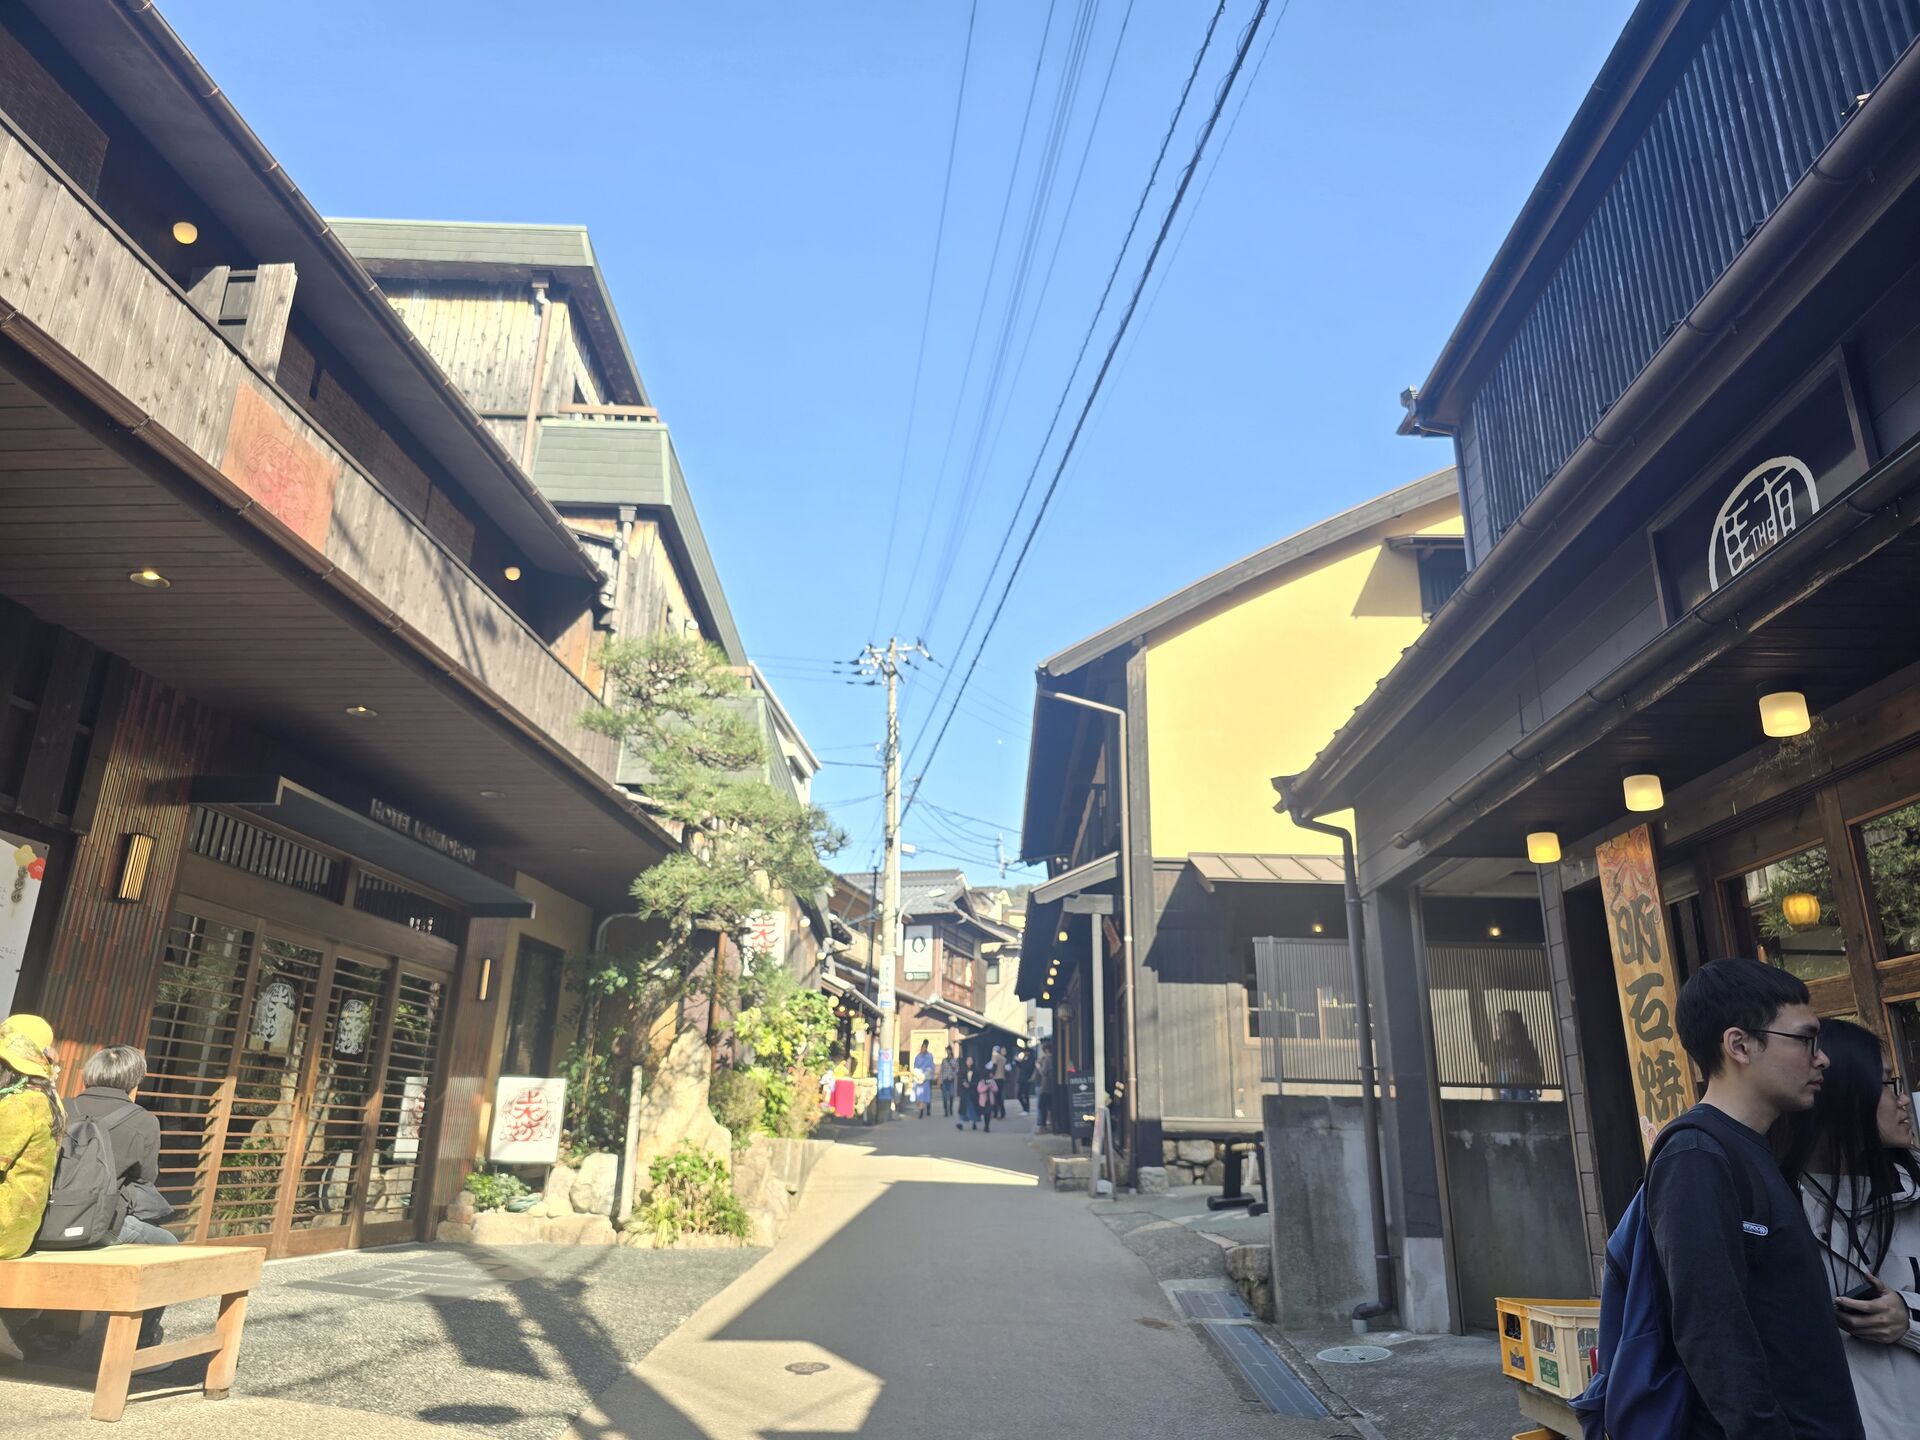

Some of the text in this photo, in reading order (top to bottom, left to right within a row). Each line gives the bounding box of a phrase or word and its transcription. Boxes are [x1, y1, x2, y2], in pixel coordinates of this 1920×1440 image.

[370, 798, 412, 834] HOTEL
[1613, 893, 1688, 1124] 明石焼
